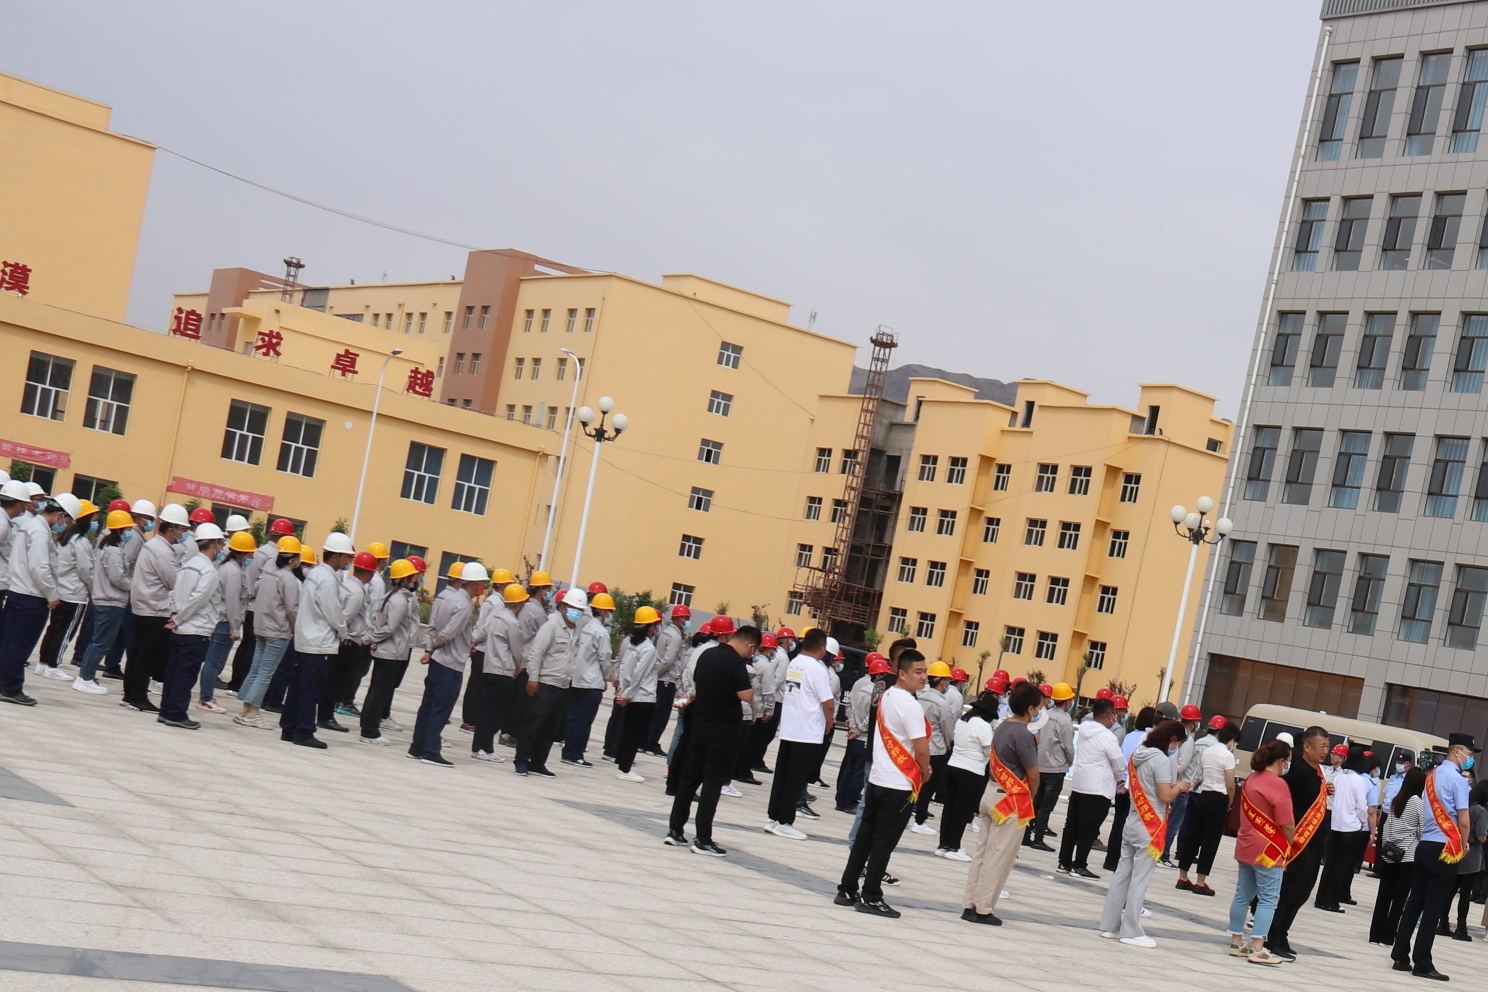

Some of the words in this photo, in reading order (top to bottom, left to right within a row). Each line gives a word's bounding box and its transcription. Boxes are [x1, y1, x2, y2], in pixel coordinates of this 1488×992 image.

[0, 261, 32, 296] 漠
[172, 307, 435, 398] 追求卓越
